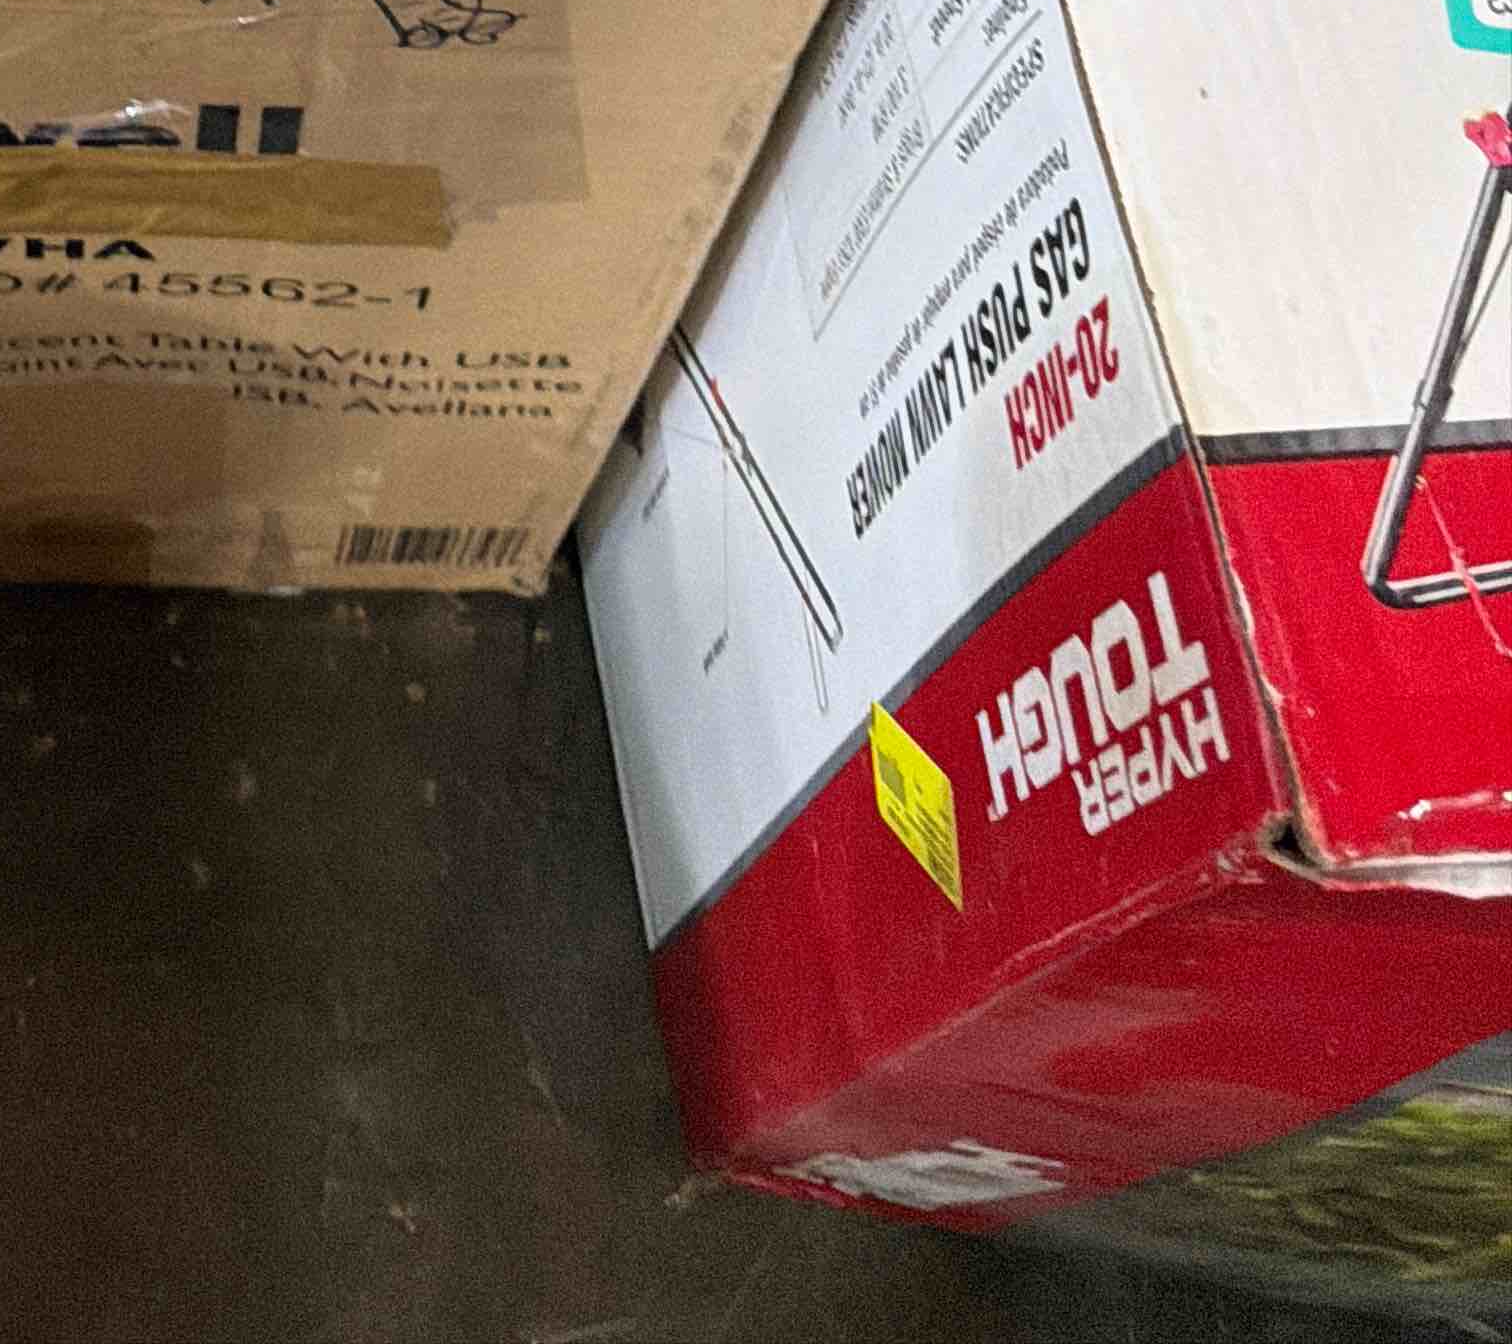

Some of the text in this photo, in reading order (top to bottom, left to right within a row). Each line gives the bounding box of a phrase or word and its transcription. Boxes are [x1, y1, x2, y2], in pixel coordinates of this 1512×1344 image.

[101, 270, 434, 311] 45562-1
[1029, 196, 1090, 319] GAS
[136, 330, 277, 355] Table
[291, 342, 430, 370] With
[455, 351, 571, 370] USB
[349, 371, 583, 392] Noisette
[961, 261, 1032, 395] PUSH
[1004, 293, 1120, 471] 20-INCH
[342, 396, 553, 418] Avellana
[906, 337, 967, 465] LAWN
[846, 408, 910, 541] MOWER
[975, 570, 1211, 820] TOUGH
[1070, 686, 1232, 837] HYPER
